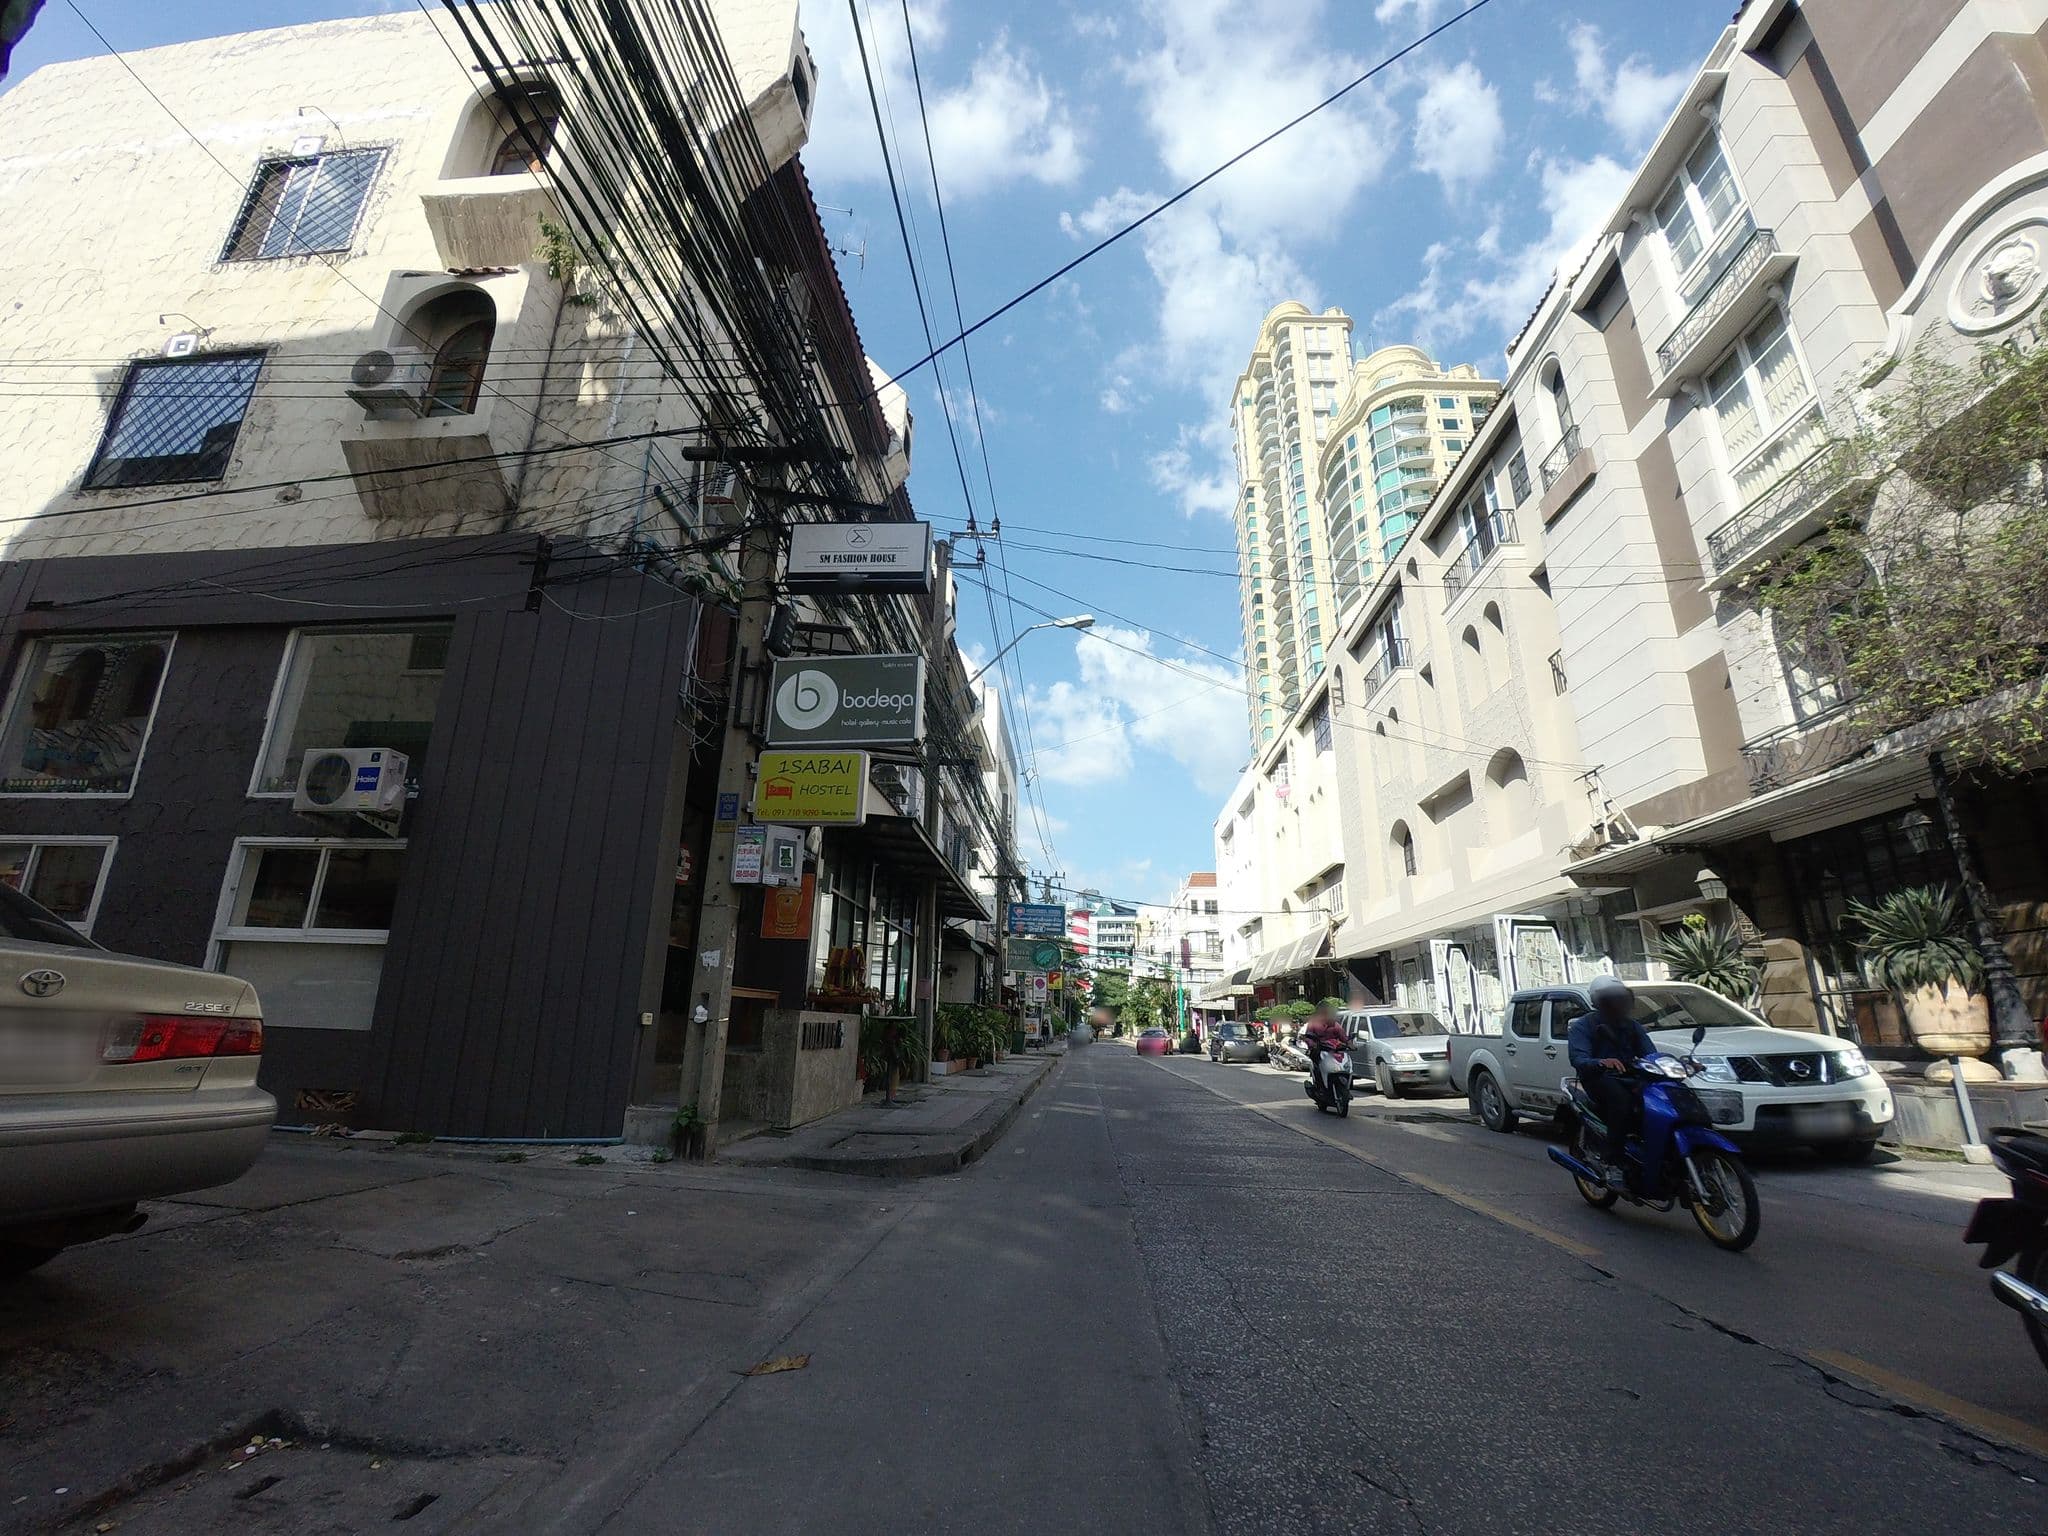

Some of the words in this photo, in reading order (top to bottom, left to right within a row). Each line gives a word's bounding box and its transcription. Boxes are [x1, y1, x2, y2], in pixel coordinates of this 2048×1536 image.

[819, 554, 831, 563] SM
[833, 553, 868, 563] FASHION
[870, 553, 897, 563] HOUSE
[843, 688, 914, 714] bodega
[778, 759, 852, 775] 1SABAI
[799, 784, 853, 796] HOSTEL
